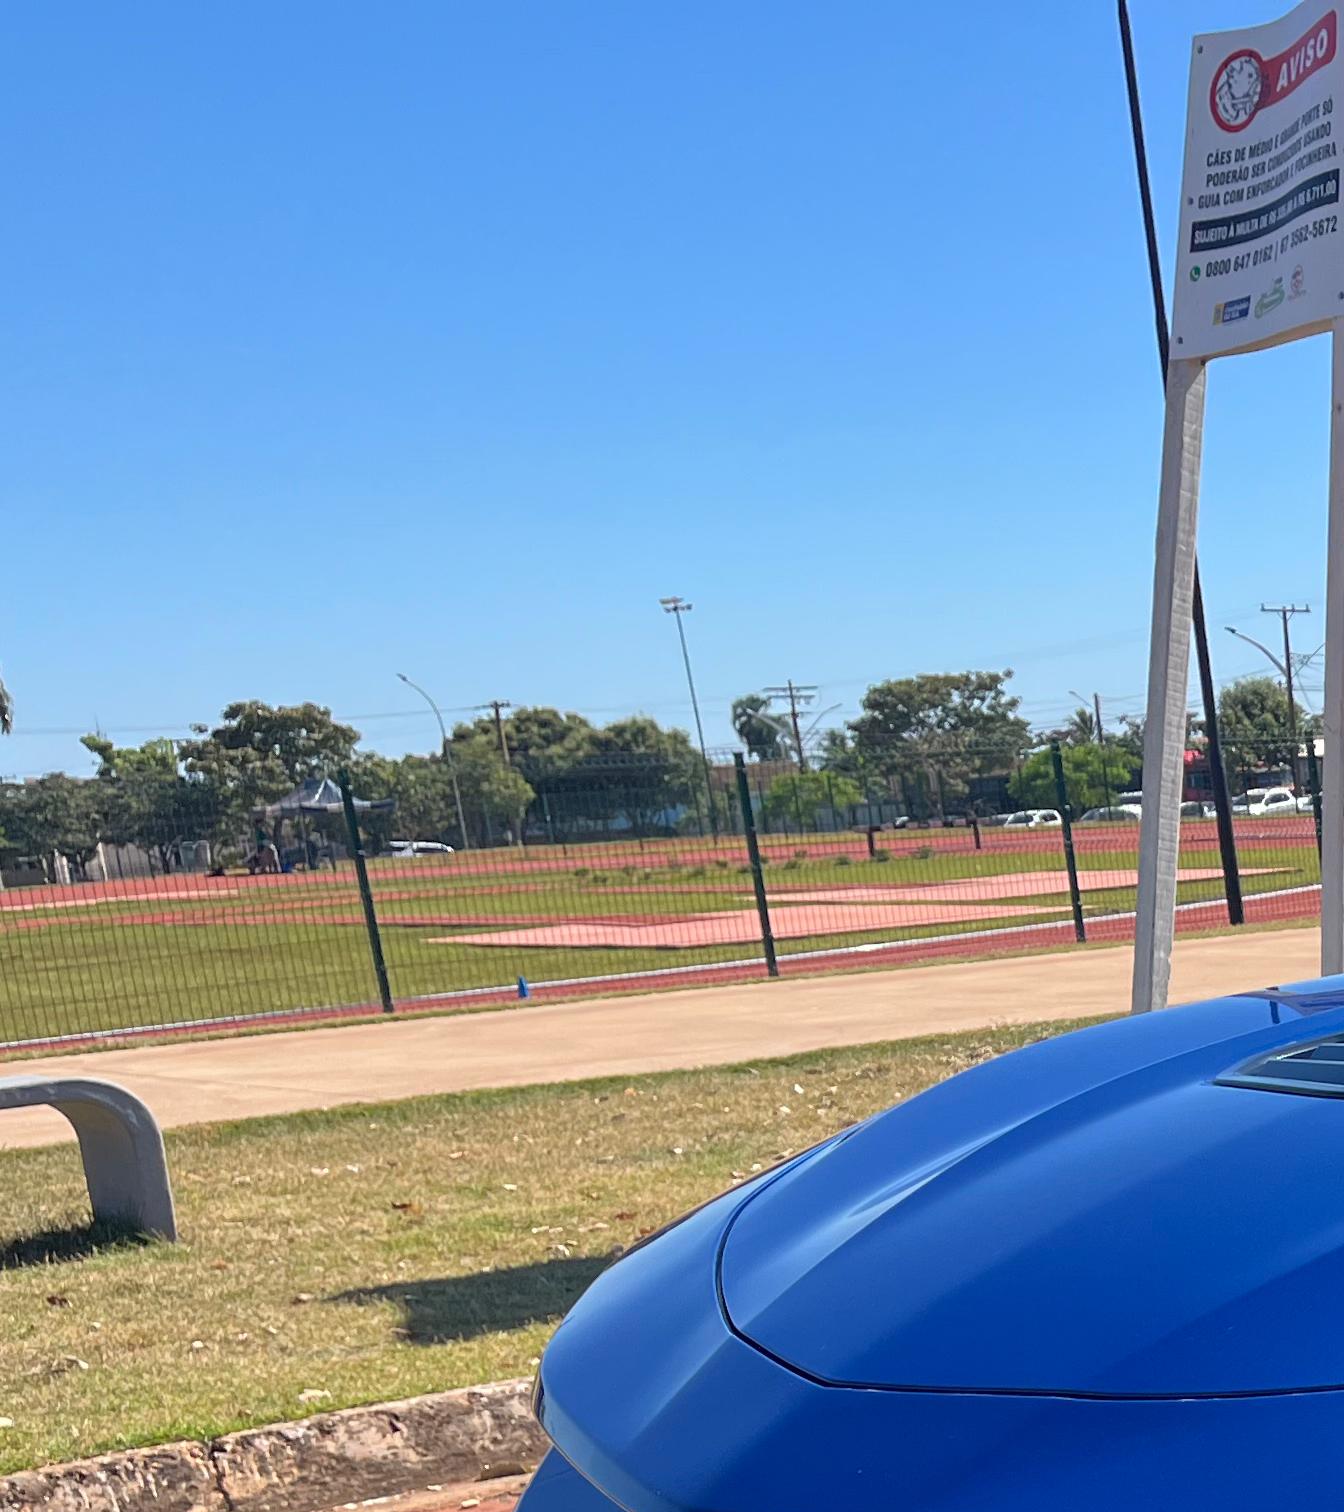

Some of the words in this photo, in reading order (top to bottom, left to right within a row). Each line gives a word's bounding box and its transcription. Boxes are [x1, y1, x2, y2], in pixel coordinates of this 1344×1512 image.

[1276, 28, 1328, 92] AVISO
[1234, 147, 1246, 163] DE
[1251, 161, 1266, 178] SER
[1198, 193, 1220, 209] GUIA
[1223, 188, 1244, 206] COM
[1206, 258, 1231, 278] 0800
[1233, 253, 1250, 272] 647
